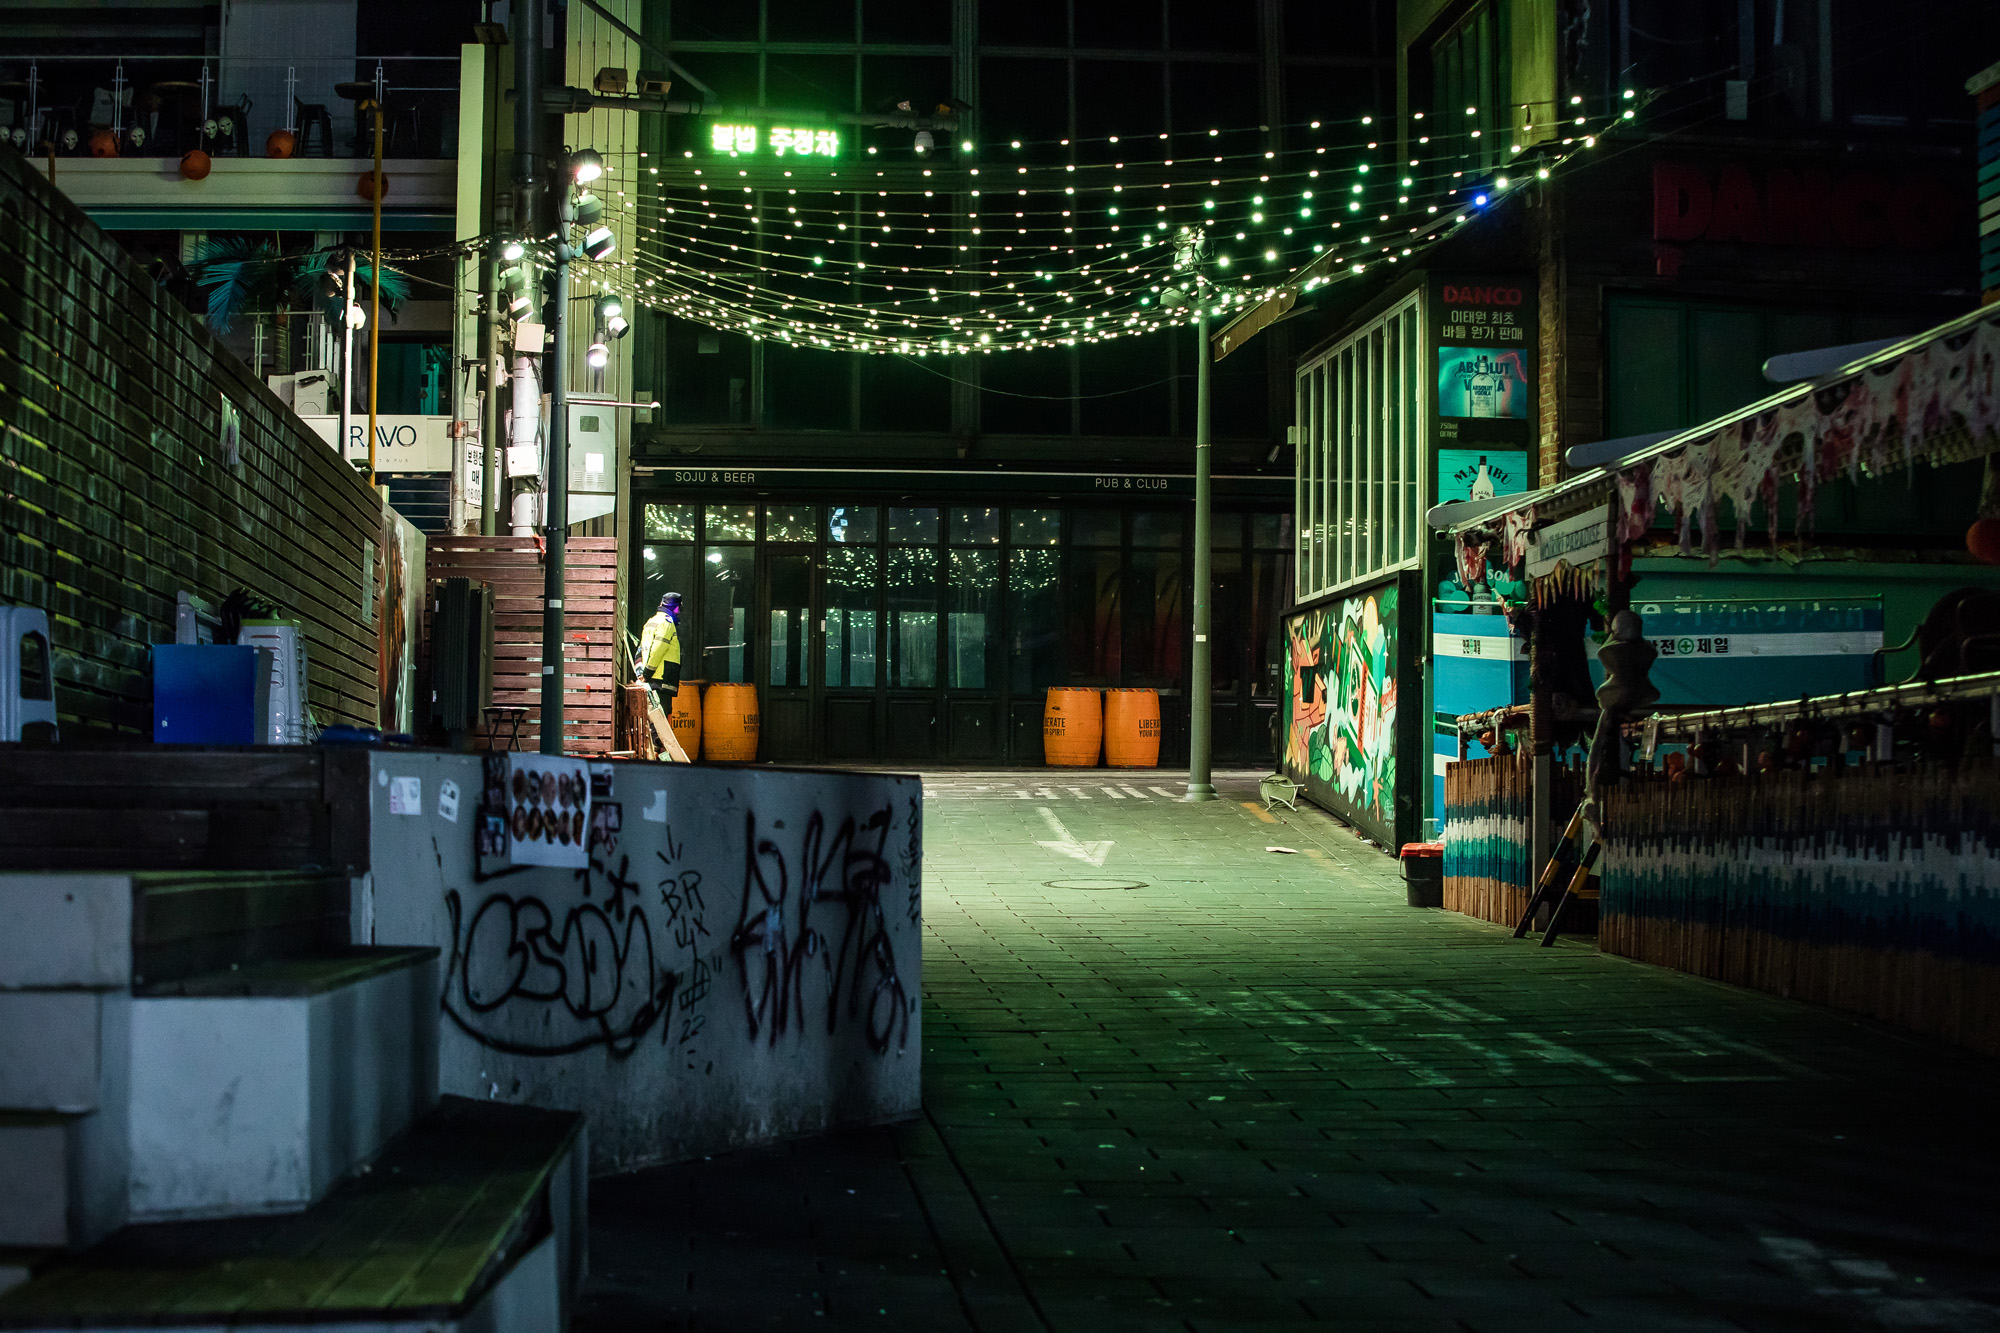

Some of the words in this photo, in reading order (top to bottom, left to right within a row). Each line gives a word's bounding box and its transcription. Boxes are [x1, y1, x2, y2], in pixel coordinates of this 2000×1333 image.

[770, 128, 839, 157] 주정차
[1652, 160, 1963, 254] DANCO
[1443, 284, 1522, 305] DANCO
[1451, 310, 1487, 325] 이태원
[1492, 311, 1515, 325] 최초
[1471, 326, 1495, 339] 원가
[1499, 327, 1523, 341] 판매
[350, 425, 417, 447] RAVO
[675, 471, 706, 482] SOJU
[711, 472, 719, 482] &
[724, 473, 755, 483] BEER
[1454, 464, 1513, 485] MAIBU
[1095, 478, 1119, 488] PUB
[1124, 478, 1131, 489] &
[1136, 479, 1168, 489] CLUB
[1452, 568, 1510, 584] JSON
[1697, 637, 1729, 654] 제일
[672, 716, 696, 729] uervo
